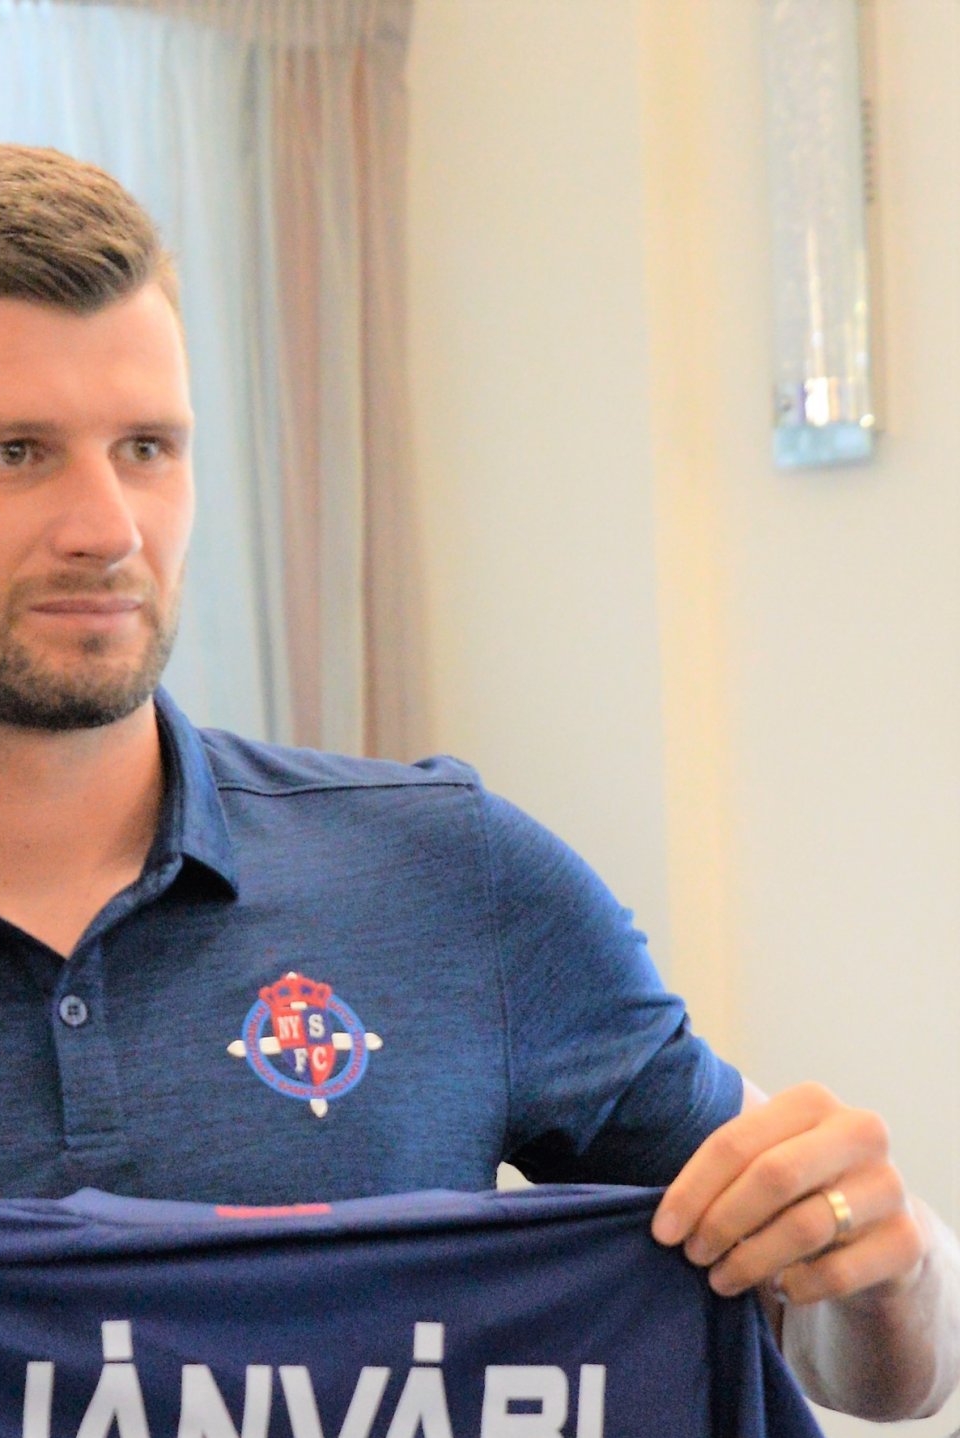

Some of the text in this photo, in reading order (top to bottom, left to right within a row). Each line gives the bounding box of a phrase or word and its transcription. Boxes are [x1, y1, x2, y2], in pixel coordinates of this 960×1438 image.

[277, 1013, 326, 1041] NY S
[294, 1046, 328, 1074] F C
